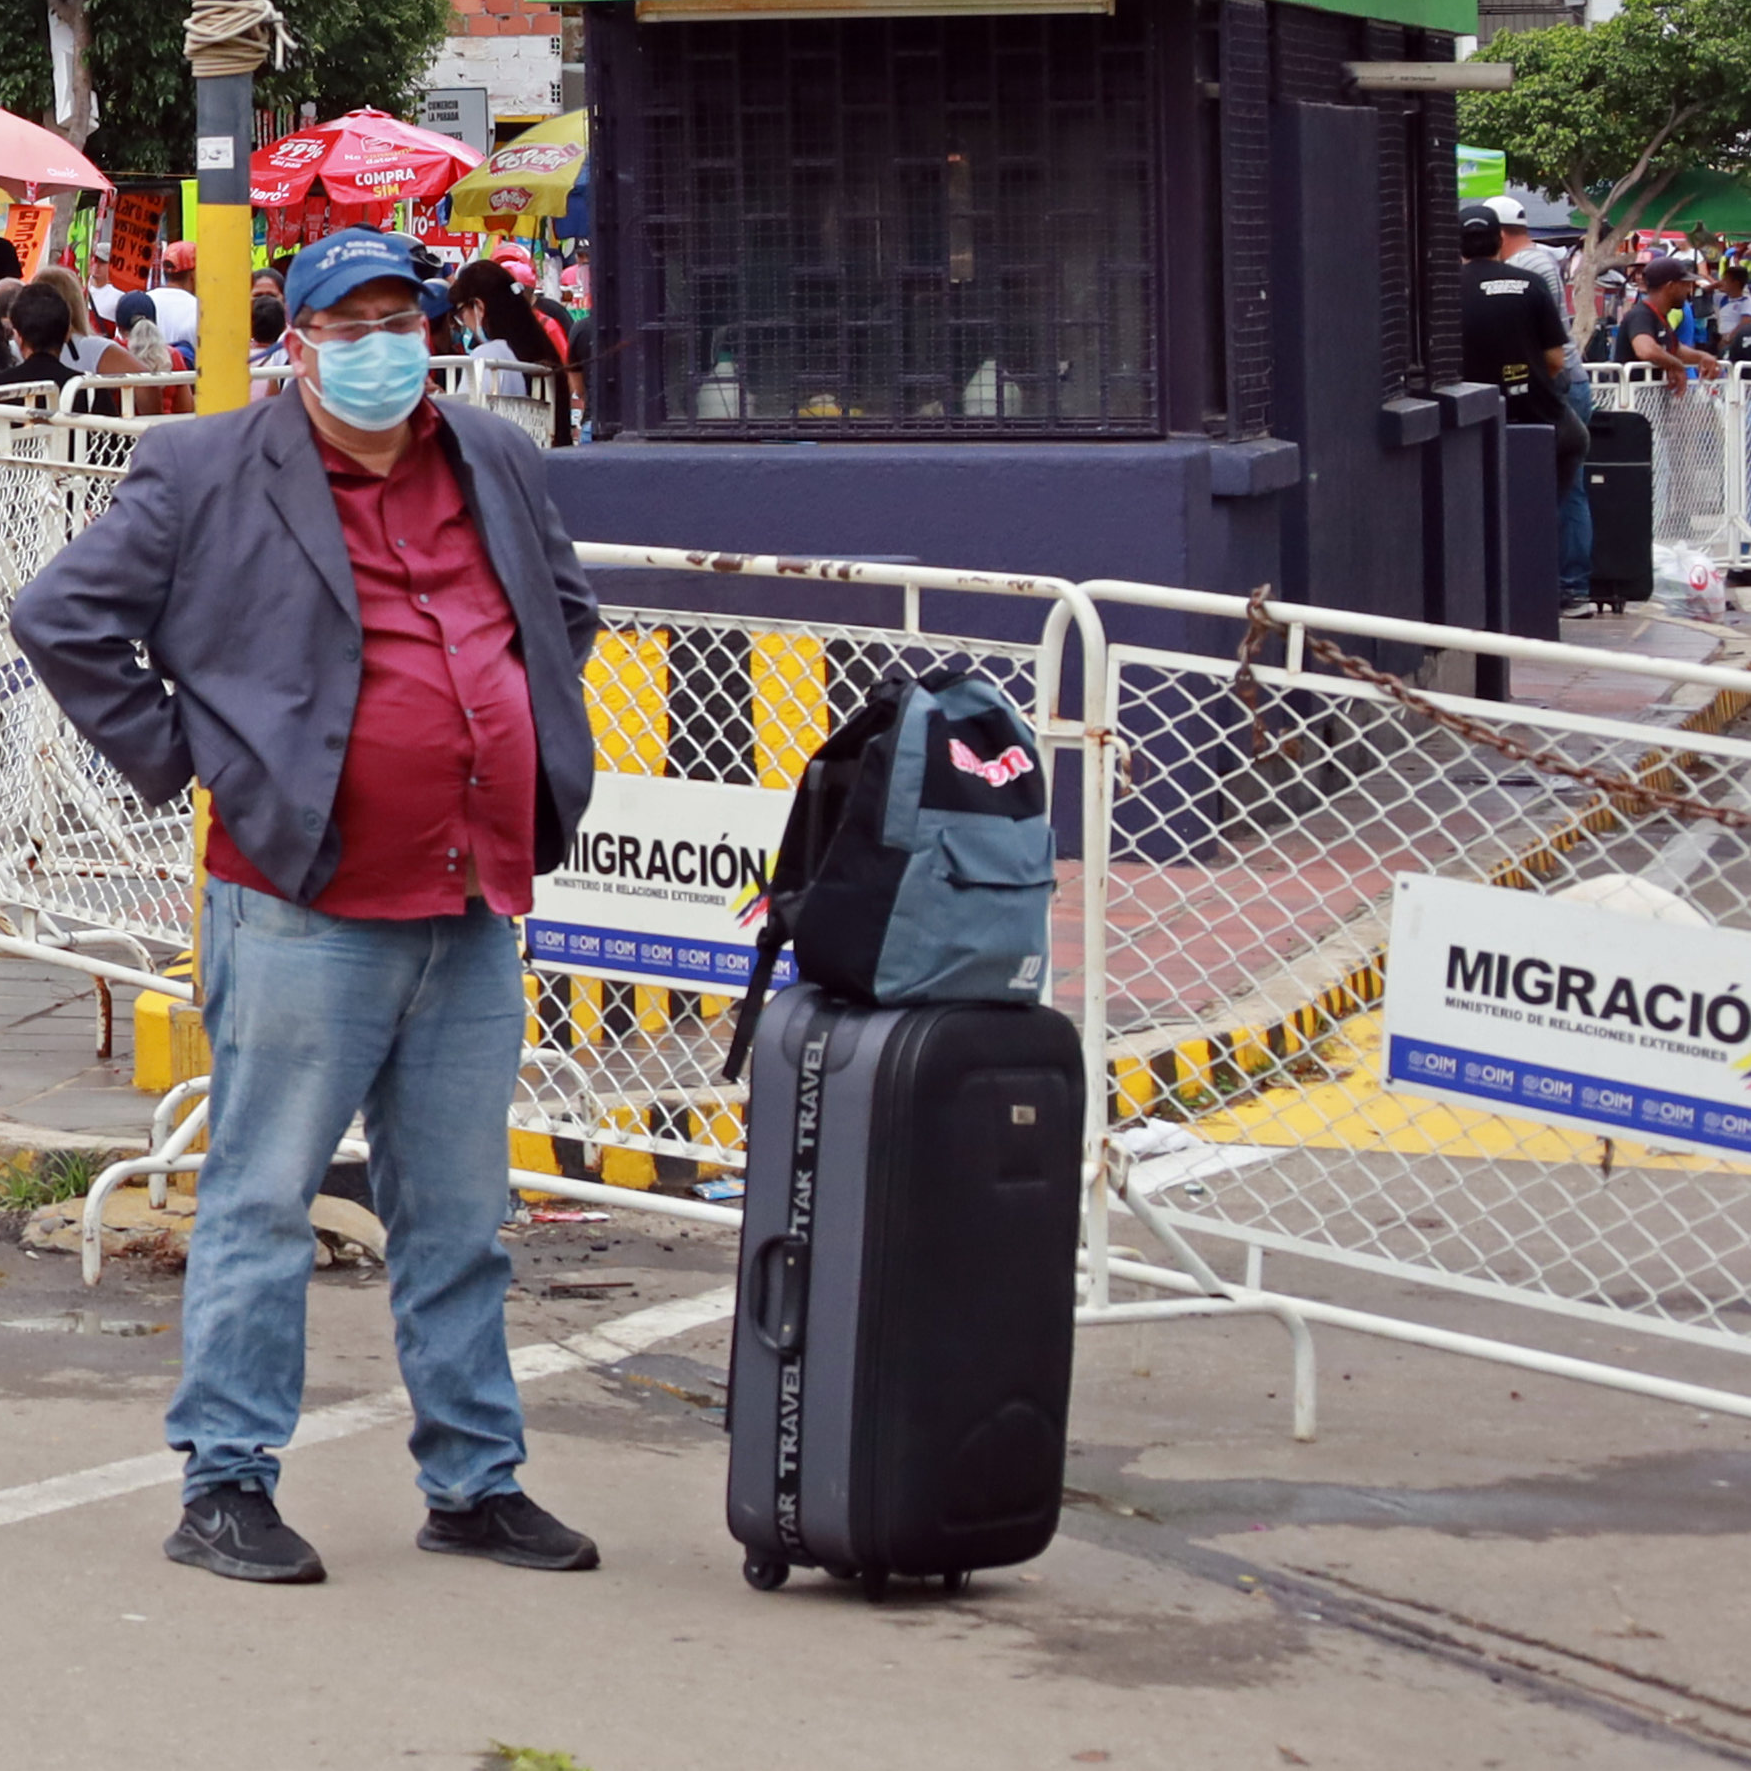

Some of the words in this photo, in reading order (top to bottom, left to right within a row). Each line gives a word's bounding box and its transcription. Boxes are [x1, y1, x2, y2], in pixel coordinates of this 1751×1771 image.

[276, 143, 326, 159] 99%
[355, 168, 416, 186] COMPRA
[250, 184, 284, 202] laro
[373, 184, 400, 198] SIM
[564, 832, 767, 892] MIGRACIÓN
[554, 877, 601, 893] MINISTERIO
[603, 882, 614, 894] DE
[616, 884, 669, 901] RELACIONES
[672, 890, 726, 907] EXTERIORES
[1445, 996, 1523, 1022] MINISTERIO
[1527, 1012, 1544, 1027] DE
[1548, 1017, 1635, 1046] RELACIONES
[1640, 1035, 1728, 1063] EXTERIORES
[1425, 1052, 1456, 1073] OIM
[1482, 1064, 1515, 1086] OIM
[798, 1032, 829, 1155] TRAVEL
[1541, 1077, 1573, 1099] OIM
[1600, 1089, 1633, 1111] OIM
[1660, 1101, 1695, 1123] OIM
[779, 1356, 802, 1478] TRAVEL
